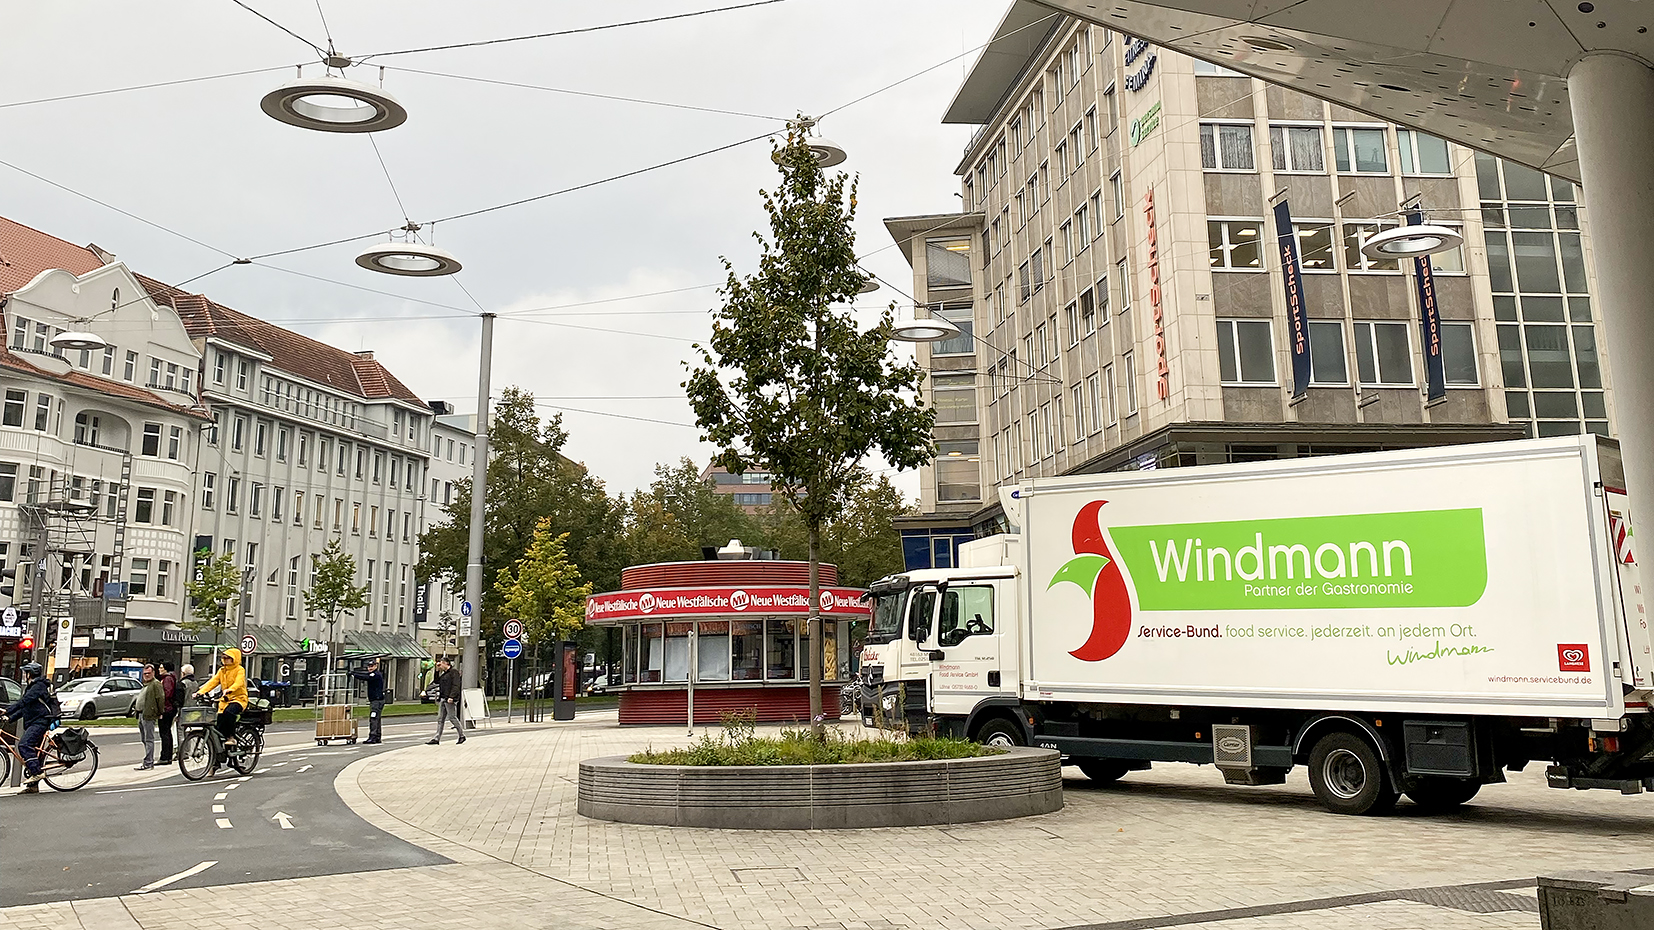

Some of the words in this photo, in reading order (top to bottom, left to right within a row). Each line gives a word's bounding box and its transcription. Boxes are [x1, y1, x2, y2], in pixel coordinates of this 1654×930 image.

[1284, 244, 1305, 355] SportScheck
[1149, 532, 1413, 583] Windmann
[1244, 584, 1292, 597] Partner
[1295, 582, 1318, 596] der
[1322, 580, 1414, 596] Gastronomie
[416, 583, 426, 615] Thalia
[656, 597, 676, 609] Neue
[677, 594, 729, 608] Westfälische
[750, 594, 772, 607] Neue
[773, 594, 810, 607] Westfälisc
[834, 595, 849, 607] Neue
[507, 624, 519, 634] 30
[1137, 624, 1223, 638] Service-Bund.
[1225, 624, 1255, 638] food
[1258, 624, 1308, 638] service.
[1310, 623, 1374, 641] jederzeit.
[1377, 627, 1396, 638] an
[1399, 623, 1446, 641] jedem
[1449, 624, 1477, 638] Ort.
[243, 640, 253, 649] 30
[309, 641, 328, 652] Thali
[1487, 675, 1592, 685] windmann.servicebund.de
